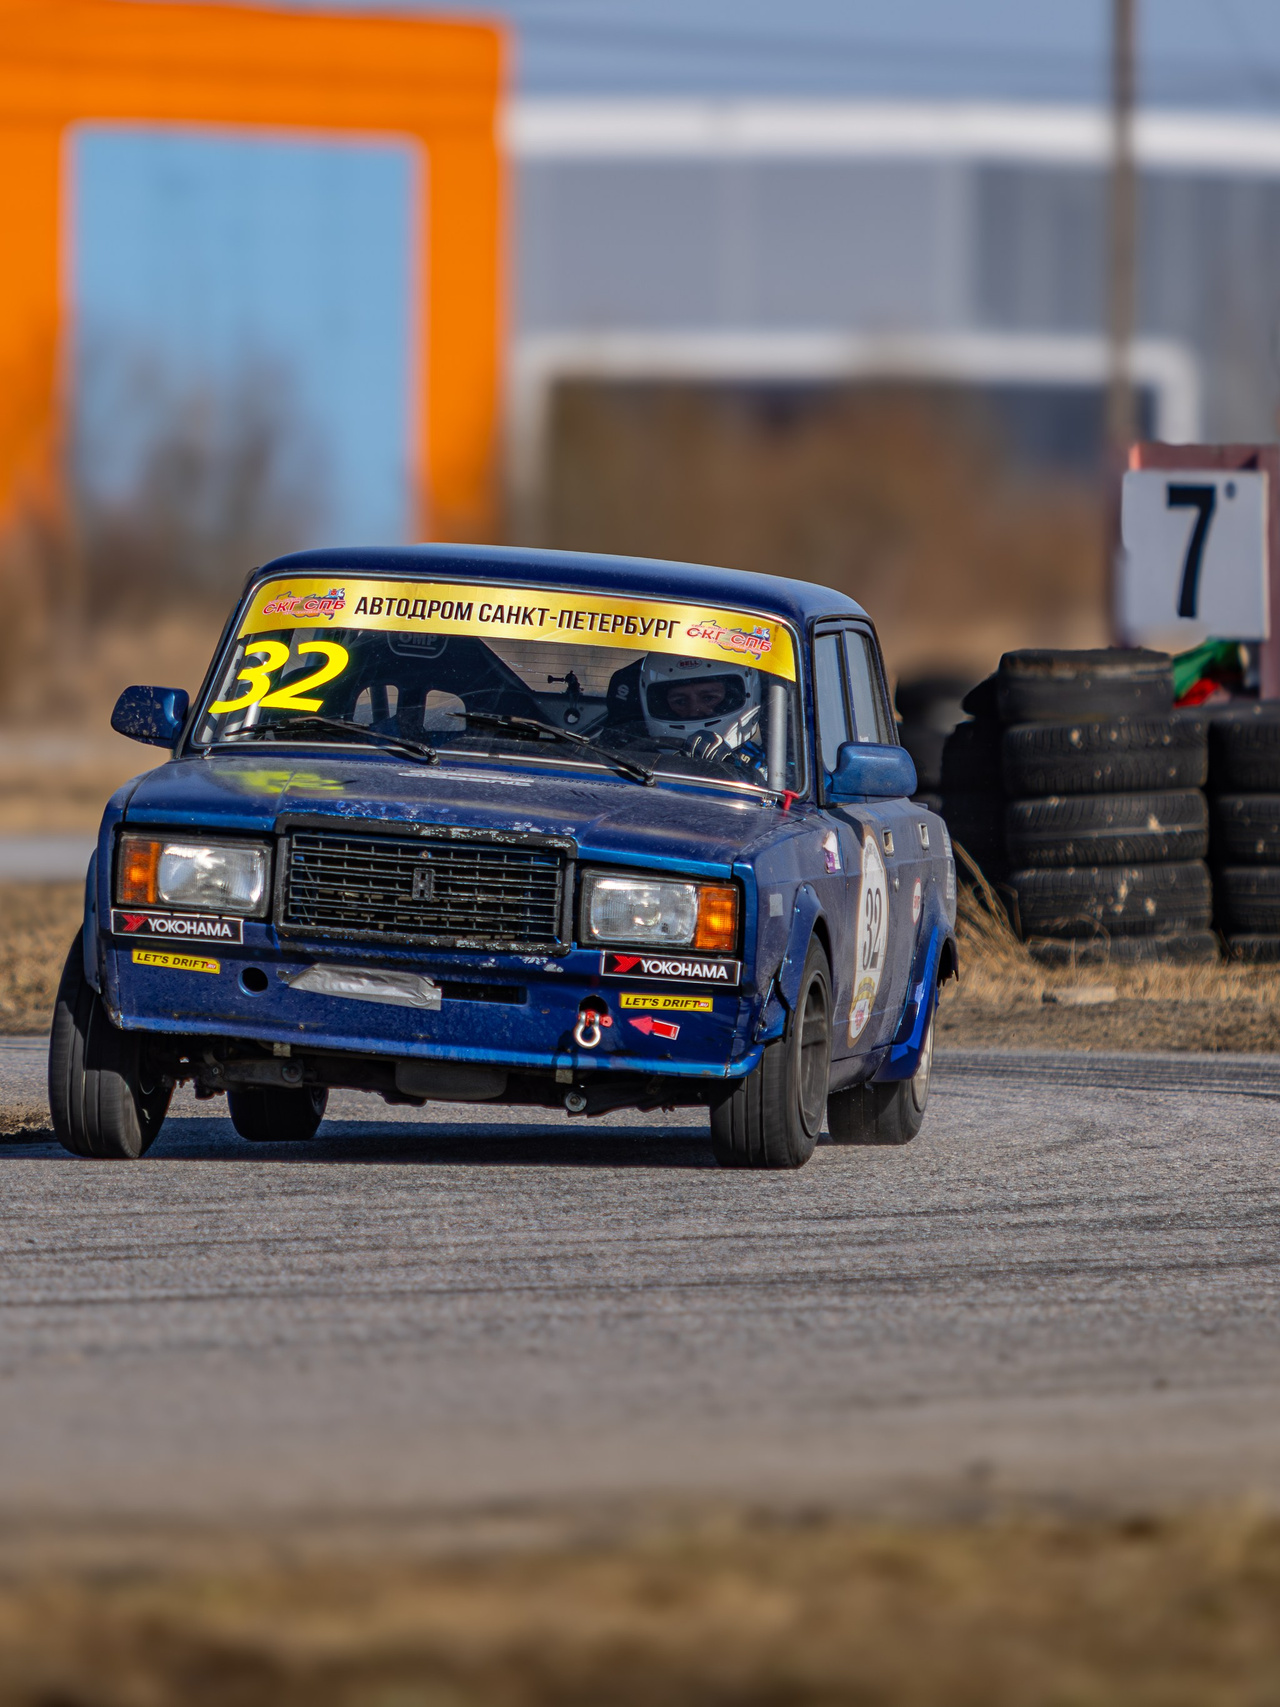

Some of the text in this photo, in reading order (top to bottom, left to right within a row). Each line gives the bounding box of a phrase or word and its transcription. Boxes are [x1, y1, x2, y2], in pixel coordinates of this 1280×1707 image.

[262, 600, 300, 615] СКГ
[304, 600, 346, 610] СПБ
[354, 596, 681, 639] АВТОДРОМ САНКТ-ПЕТЕРБУРГ
[686, 627, 725, 641] СКГ
[730, 634, 772, 652] СПБ
[208, 640, 349, 714] 32
[147, 917, 233, 938] YOKOHAMA
[862, 887, 883, 971] 32
[136, 952, 169, 964] LET'S
[641, 959, 729, 980] YOKOHAMA
[625, 997, 660, 1007] LET'S
